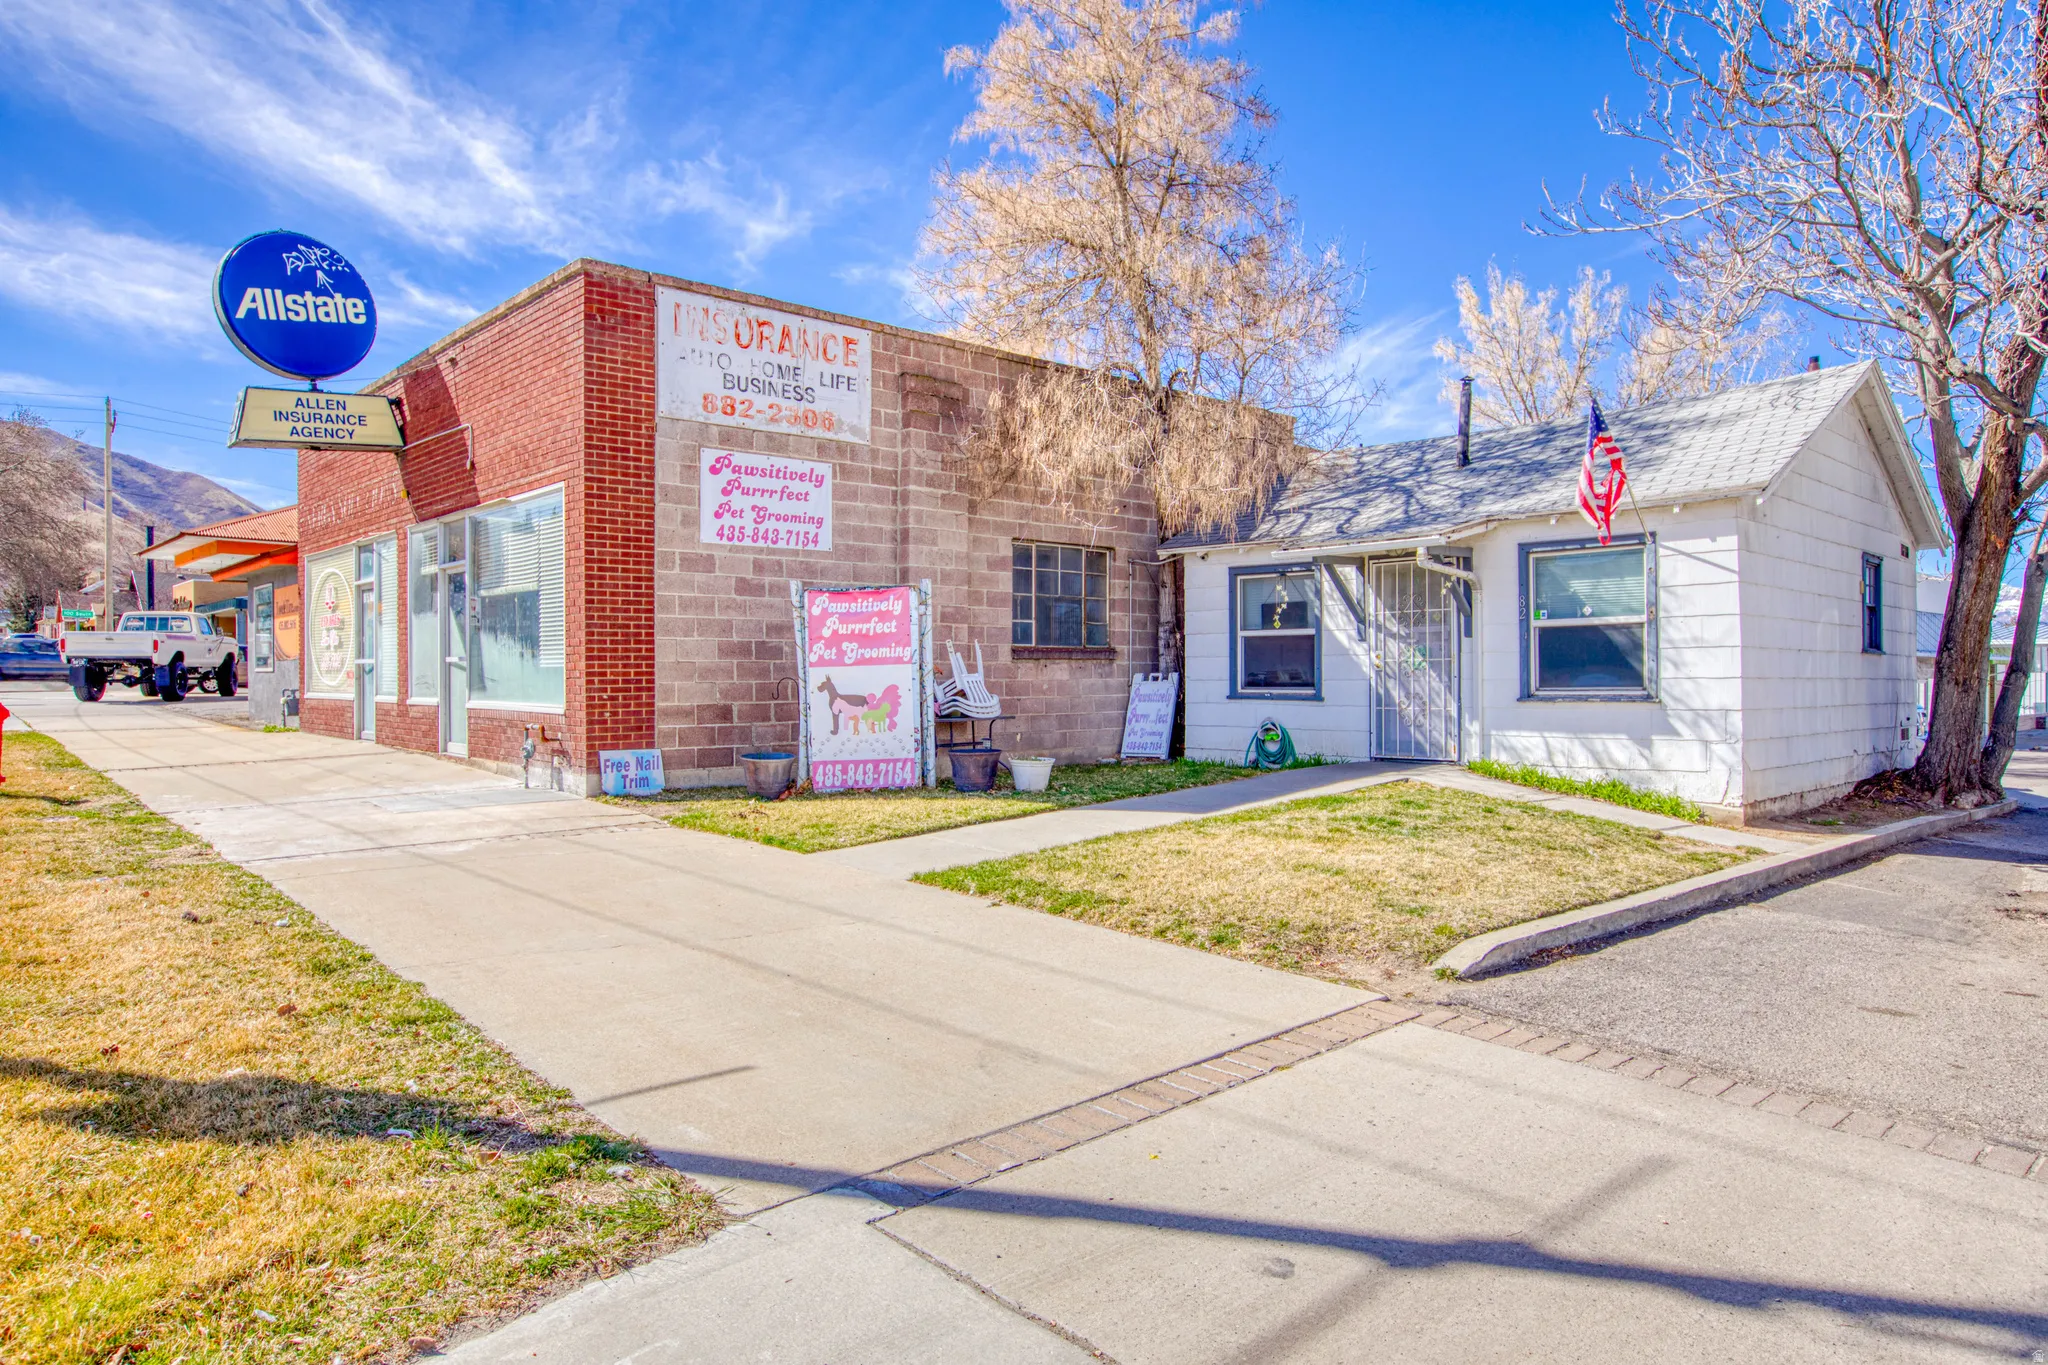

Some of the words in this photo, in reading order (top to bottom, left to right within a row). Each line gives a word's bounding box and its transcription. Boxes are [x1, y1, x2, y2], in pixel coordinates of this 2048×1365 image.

[235, 287, 367, 324] Allstate
[673, 302, 859, 368] INSURANCE
[750, 358, 802, 383] HOME
[819, 371, 858, 392] LIFE
[723, 372, 816, 404] BUSINESS
[294, 397, 347, 411] ALLEN
[273, 410, 368, 427] INSURANCE
[289, 426, 356, 440] AGENCY
[708, 453, 825, 489] Pawsitively
[720, 476, 811, 503] Purrrfect
[713, 499, 745, 519] Pet
[751, 504, 824, 529] Grooming
[716, 524, 819, 548] 435-843-7154
[811, 593, 903, 616] Pawsitively
[821, 614, 898, 638] Purrrfect
[809, 640, 838, 663] Pet
[842, 641, 911, 664] Grooming
[603, 758, 631, 774] Free
[635, 755, 660, 771] Nail
[815, 762, 913, 787] 435-843-7154
[621, 773, 650, 790] Trim
